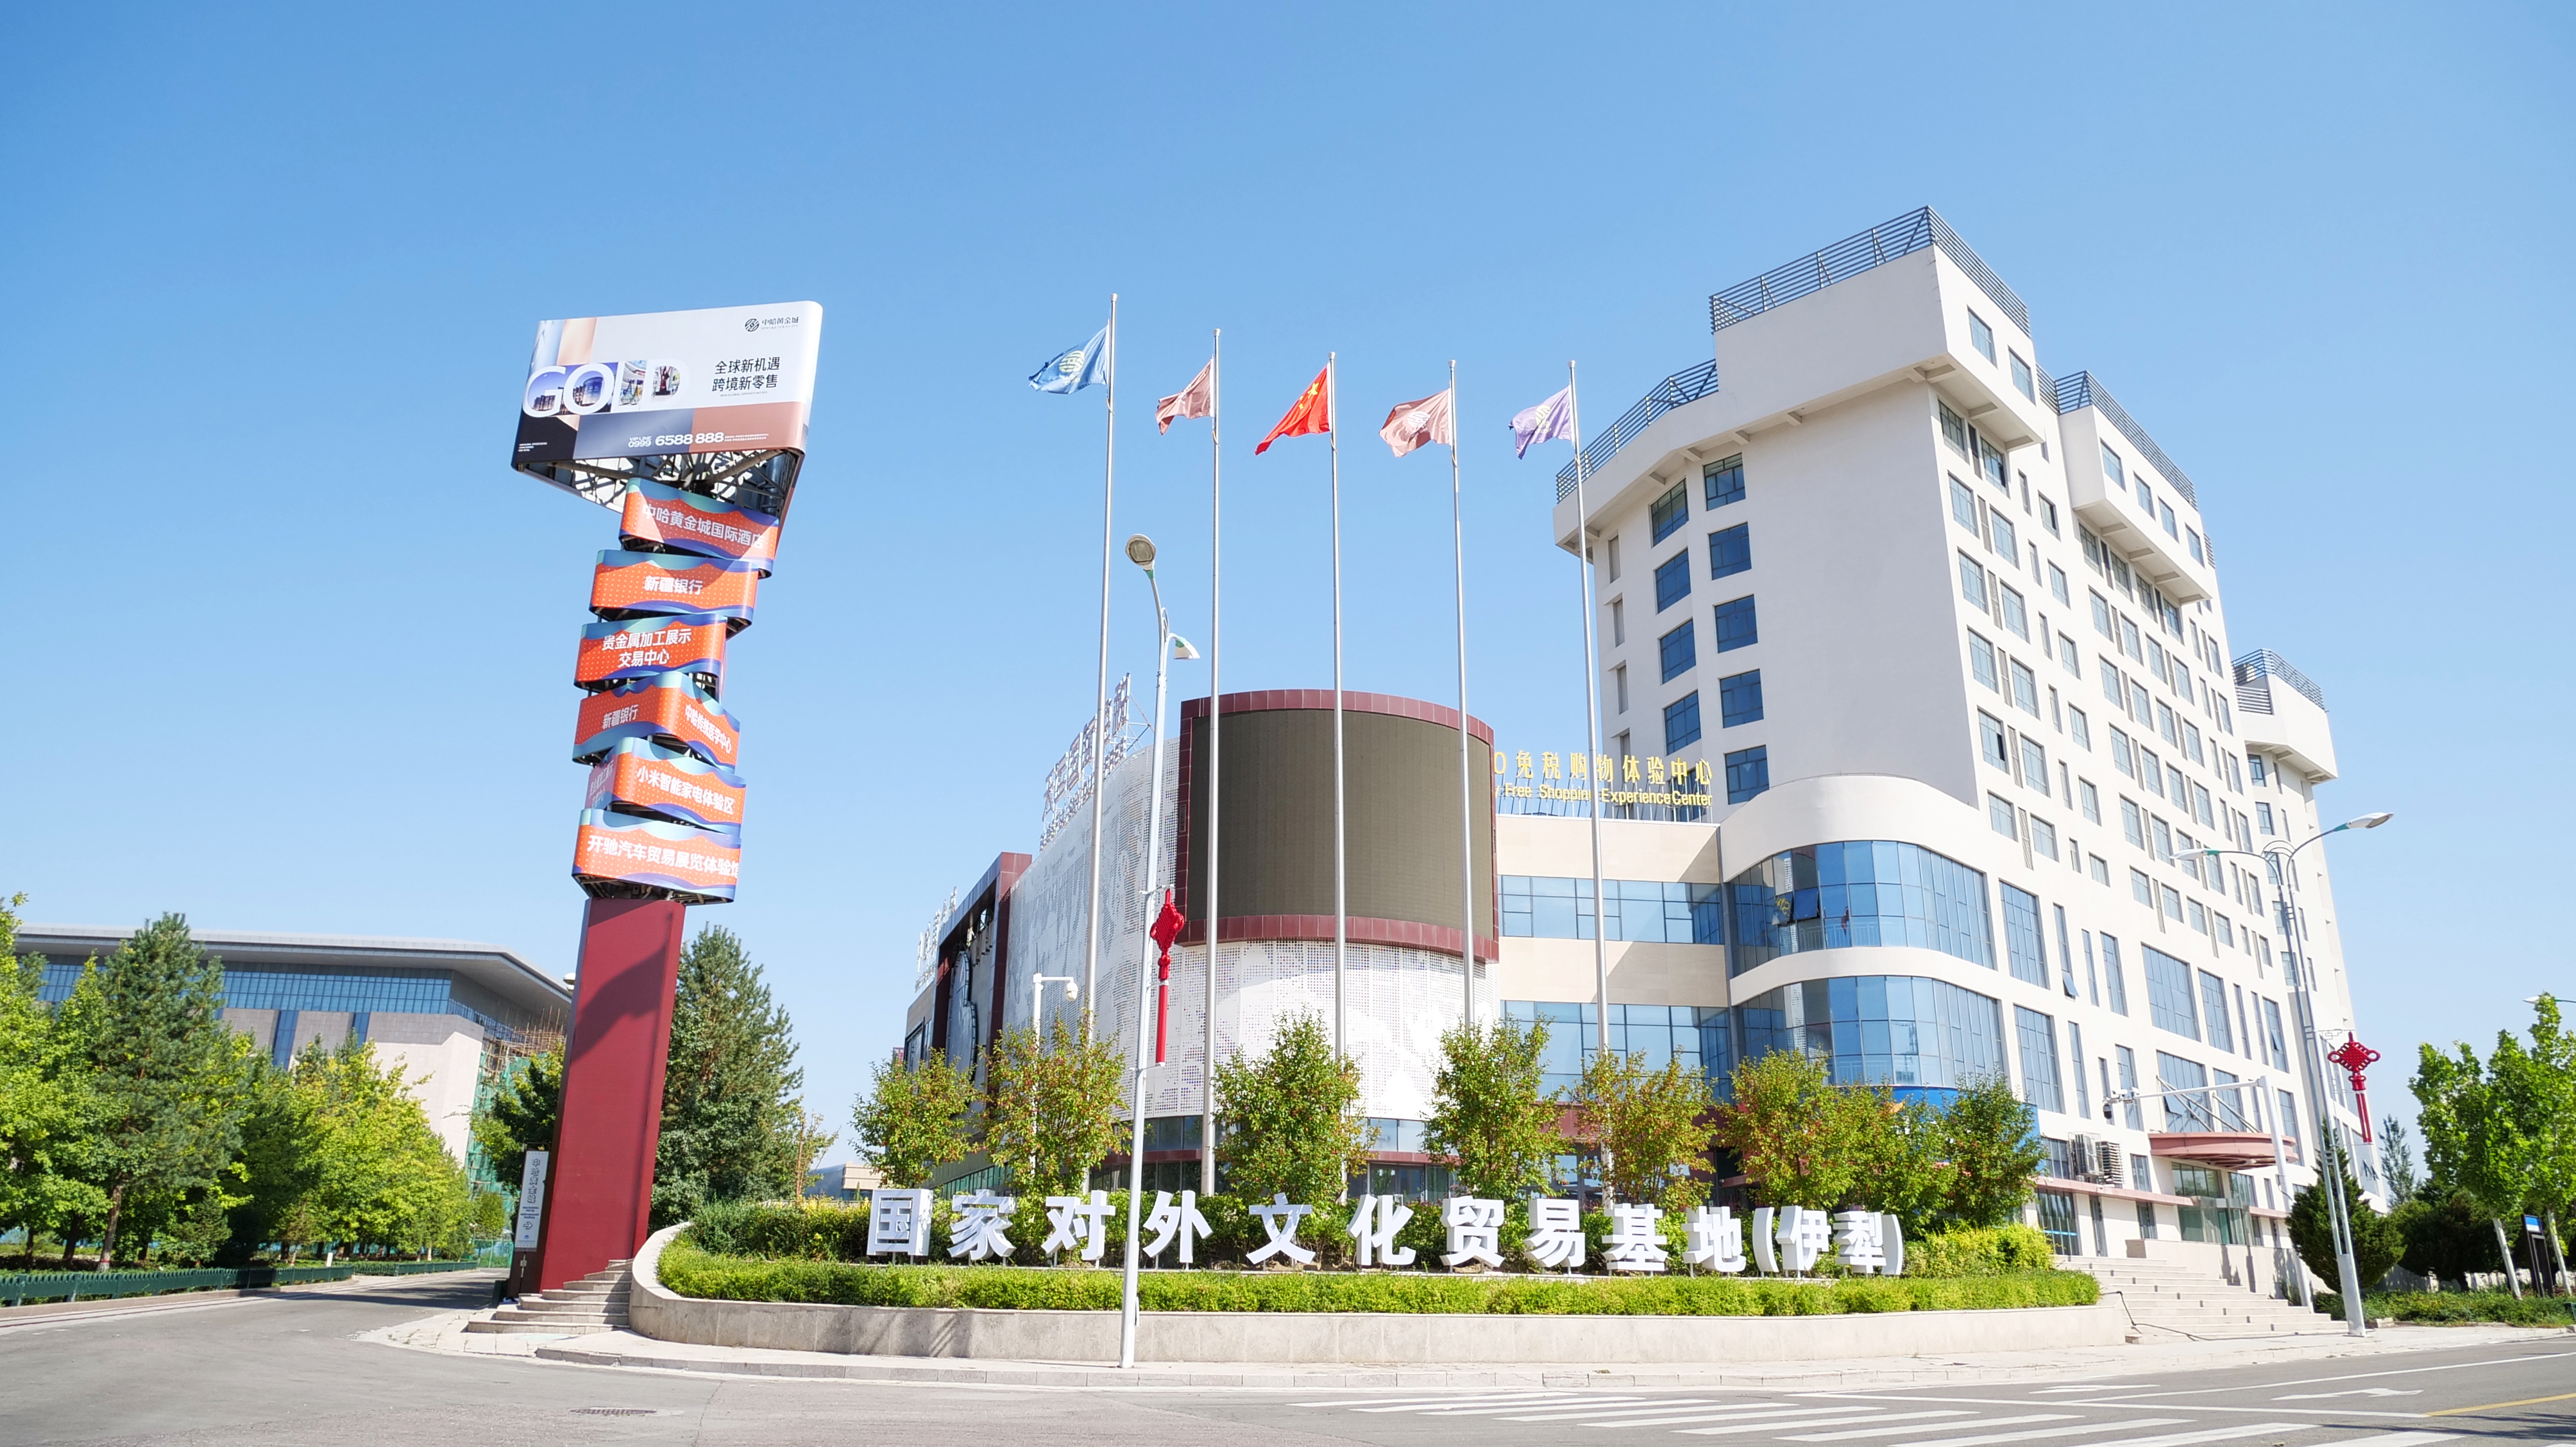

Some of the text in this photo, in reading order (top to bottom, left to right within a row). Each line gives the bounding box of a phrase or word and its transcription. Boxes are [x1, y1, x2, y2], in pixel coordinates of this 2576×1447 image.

[715, 357, 780, 374] 全球新机遇
[522, 359, 690, 418] GOLD
[711, 374, 778, 391] 跨境新零售
[655, 434, 693, 446] 6588
[695, 432, 725, 444] 888
[643, 503, 765, 550] 中哈黄金城国际酒店
[643, 575, 703, 595] 新疆银行
[602, 628, 692, 651] 贵金属加工展示
[618, 649, 670, 668] 交易中心
[602, 704, 639, 730] 新疆银行
[636, 765, 735, 815] 小米智能家电体验区
[1505, 783, 1532, 798] Free
[1601, 788, 1671, 807] Experience
[1672, 790, 1713, 806] Center
